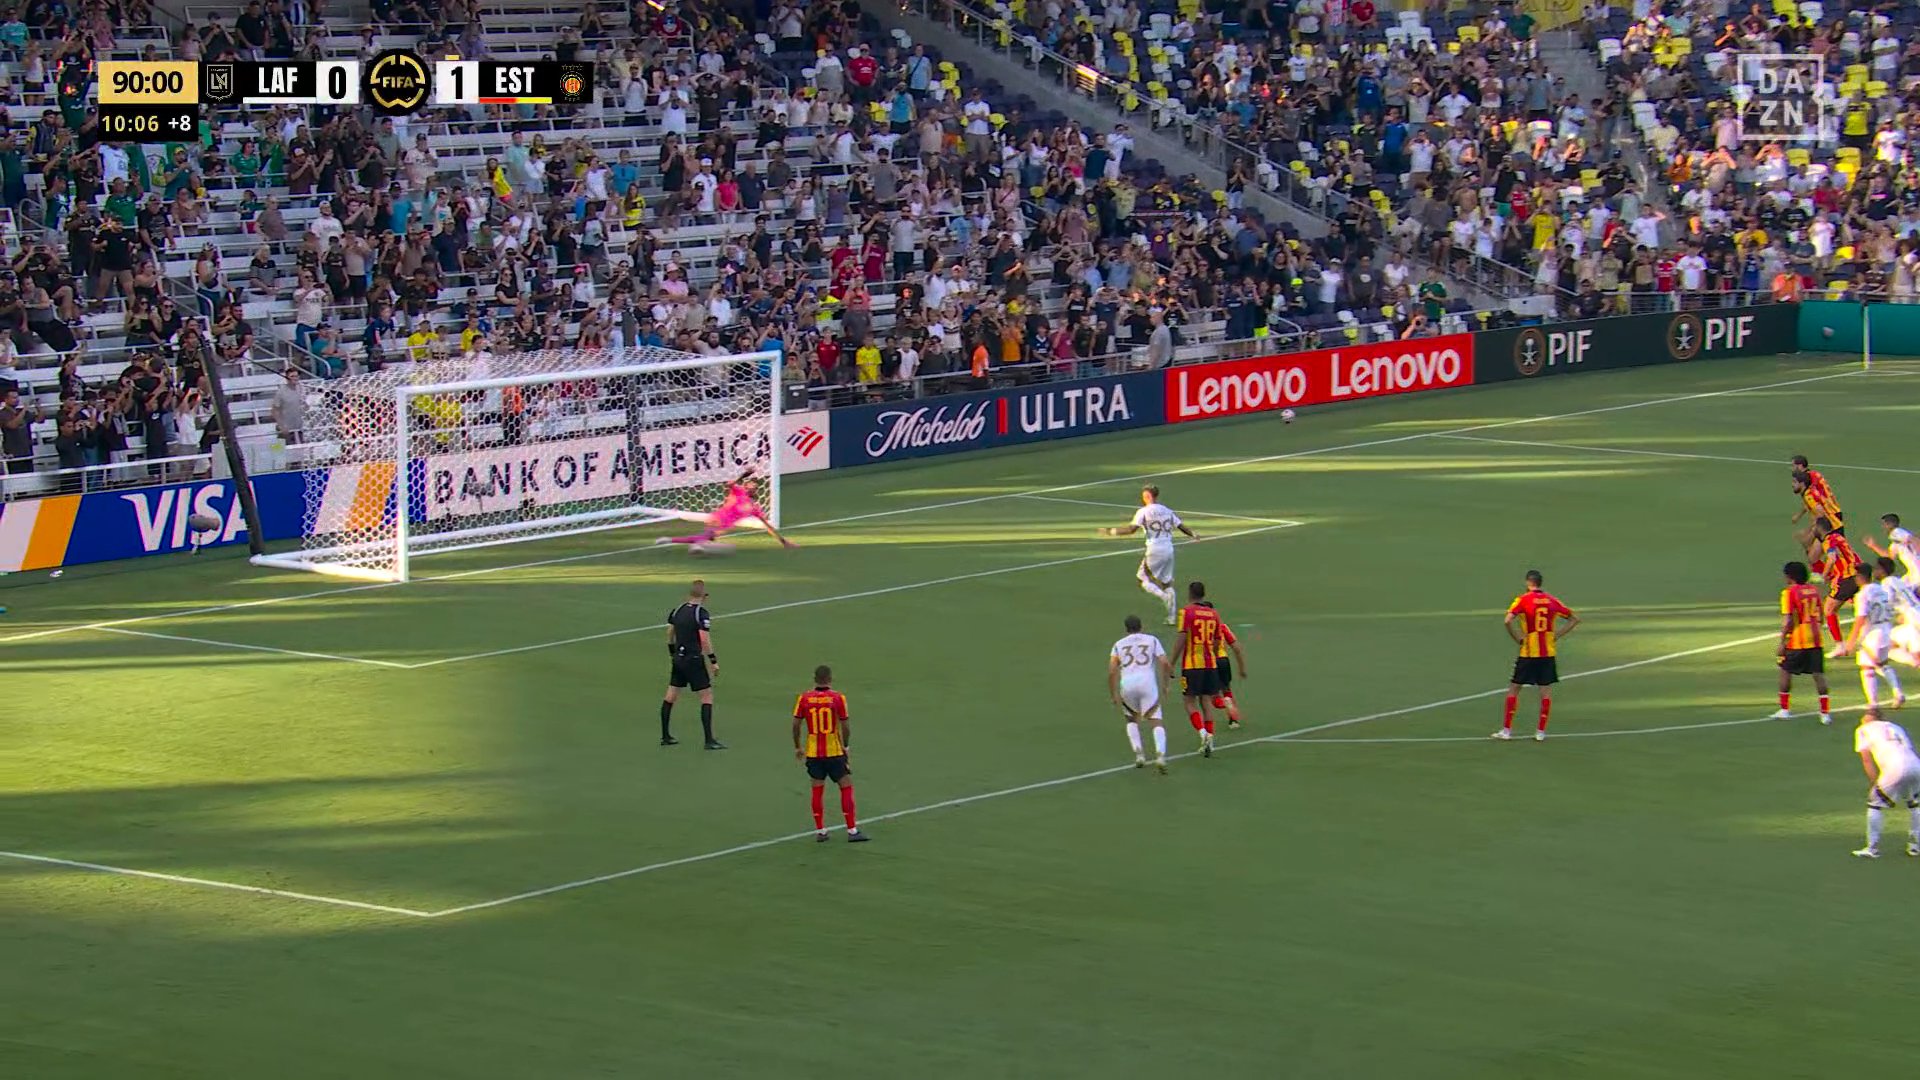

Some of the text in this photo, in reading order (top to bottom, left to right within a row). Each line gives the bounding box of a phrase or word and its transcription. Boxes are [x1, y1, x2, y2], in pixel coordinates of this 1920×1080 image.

[1549, 328, 1593, 366] PIF
[1704, 315, 1755, 351] PIF
[1179, 366, 1306, 417] Lenovo
[1333, 348, 1461, 397] Lenovo
[865, 383, 1131, 457] Michelob ULTRA
[434, 430, 772, 505] BANK OF AMERICA
[119, 480, 260, 552] VISA
[1193, 619, 1216, 645] 38
[1535, 606, 1549, 632] 6
[1121, 644, 1149, 668] 33
[809, 707, 833, 734] 10
